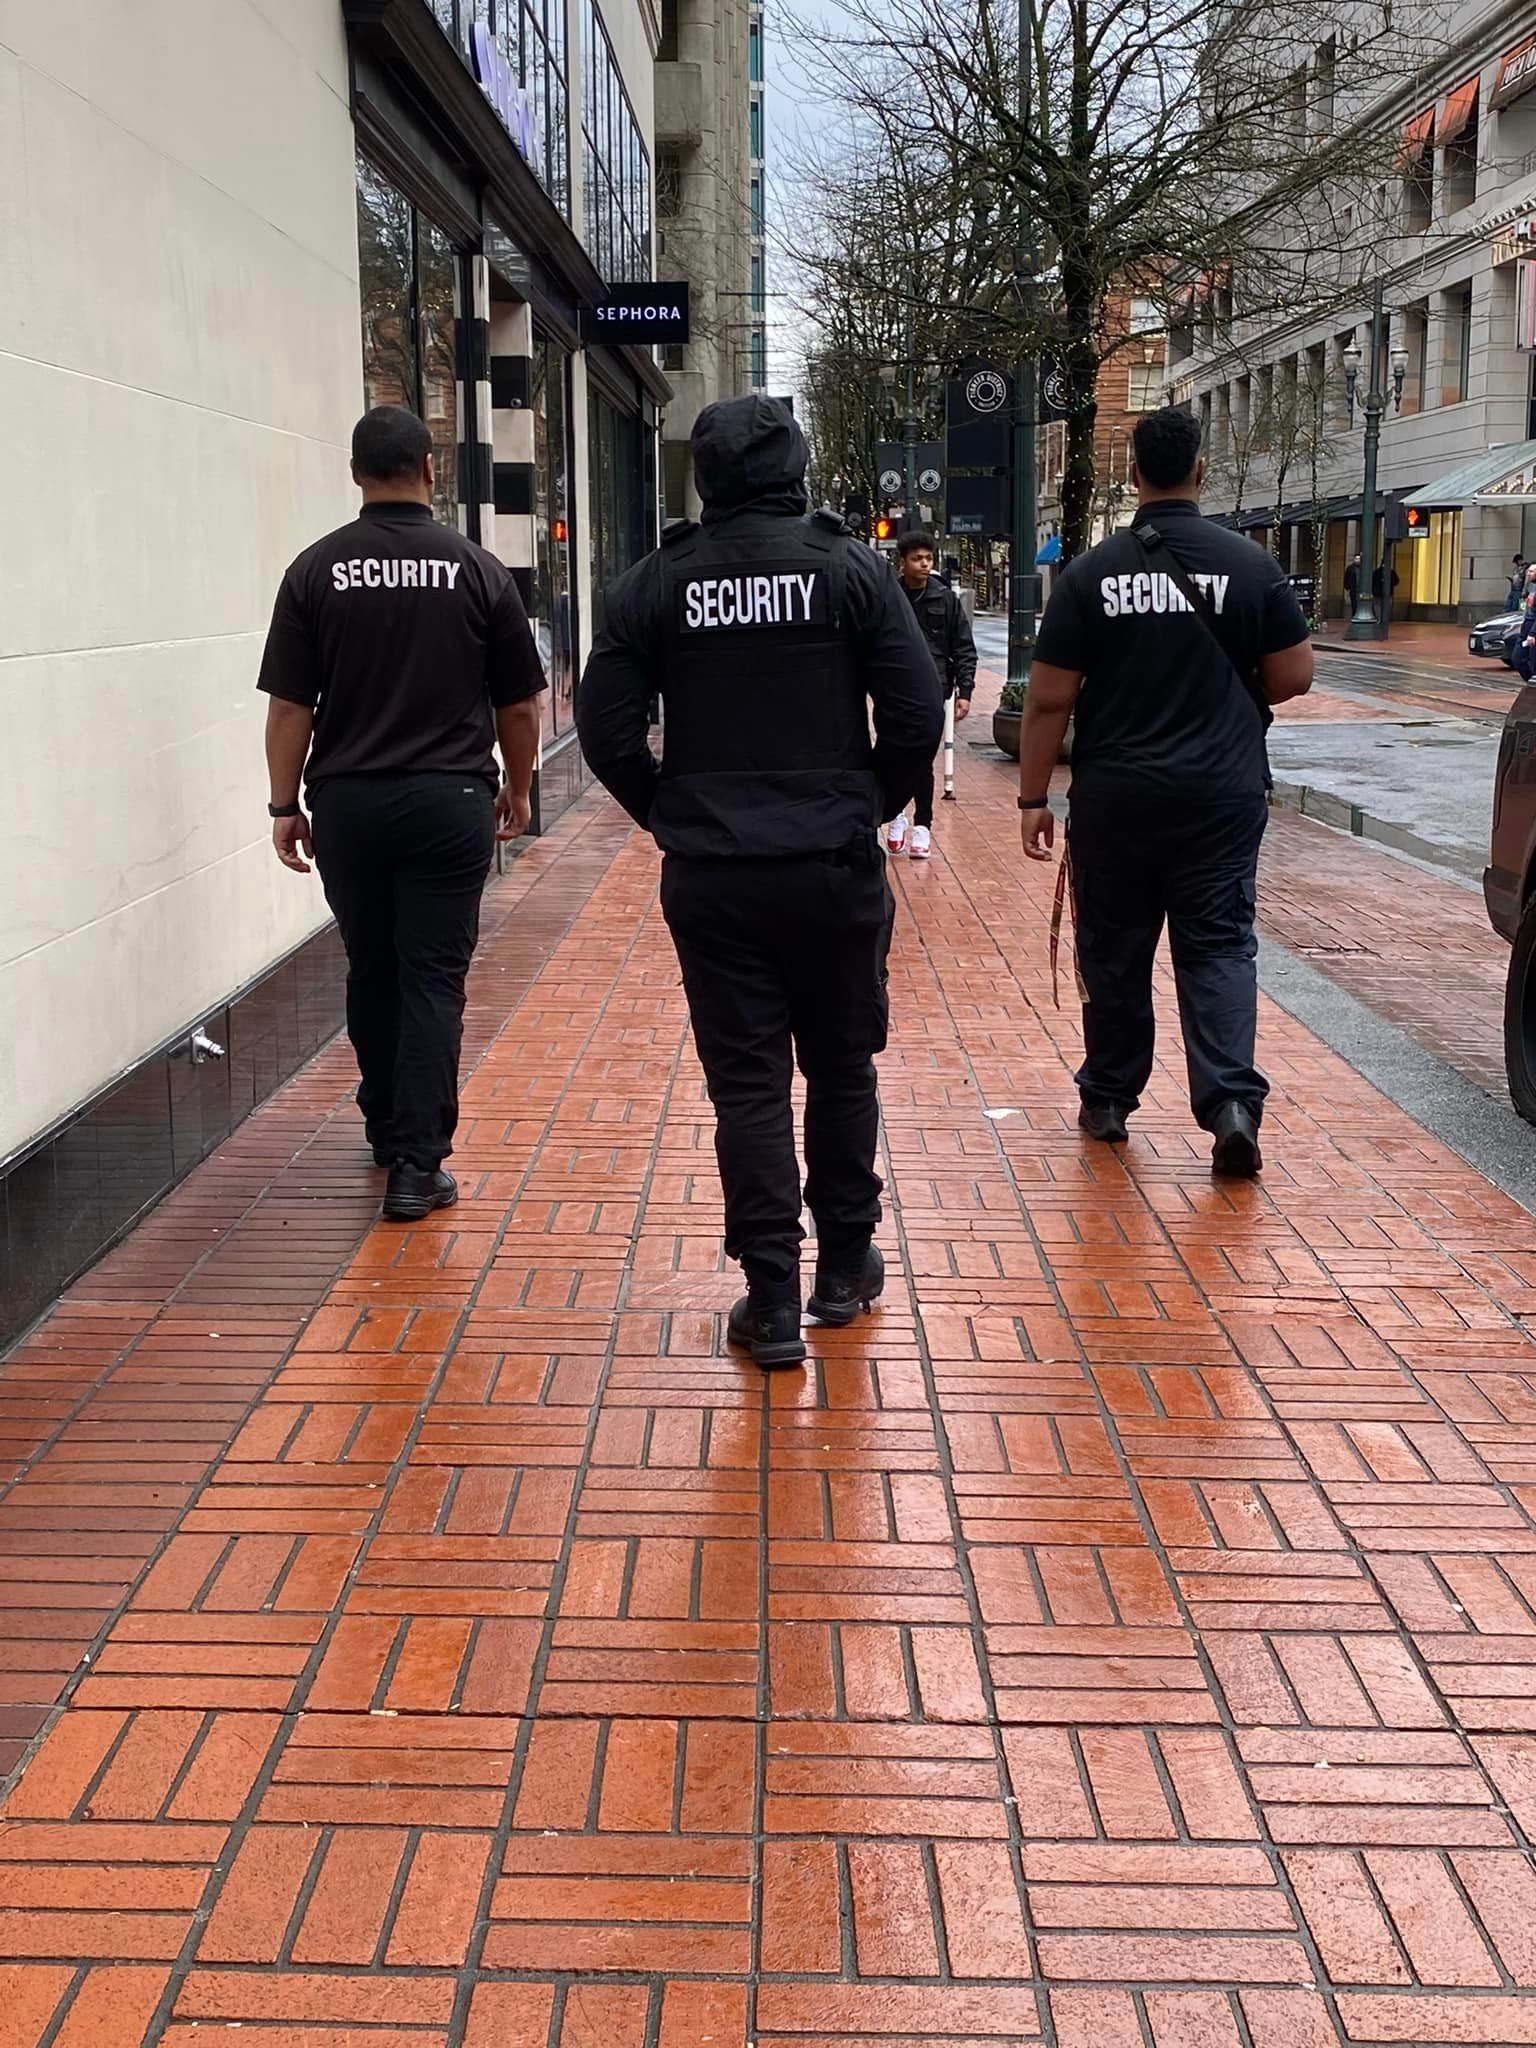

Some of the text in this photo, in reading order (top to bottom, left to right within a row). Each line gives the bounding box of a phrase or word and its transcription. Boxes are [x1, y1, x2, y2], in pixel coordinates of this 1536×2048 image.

[596, 306, 681, 320] SEPHORA
[331, 558, 461, 591] SECURITY
[685, 573, 816, 628] SECURITY
